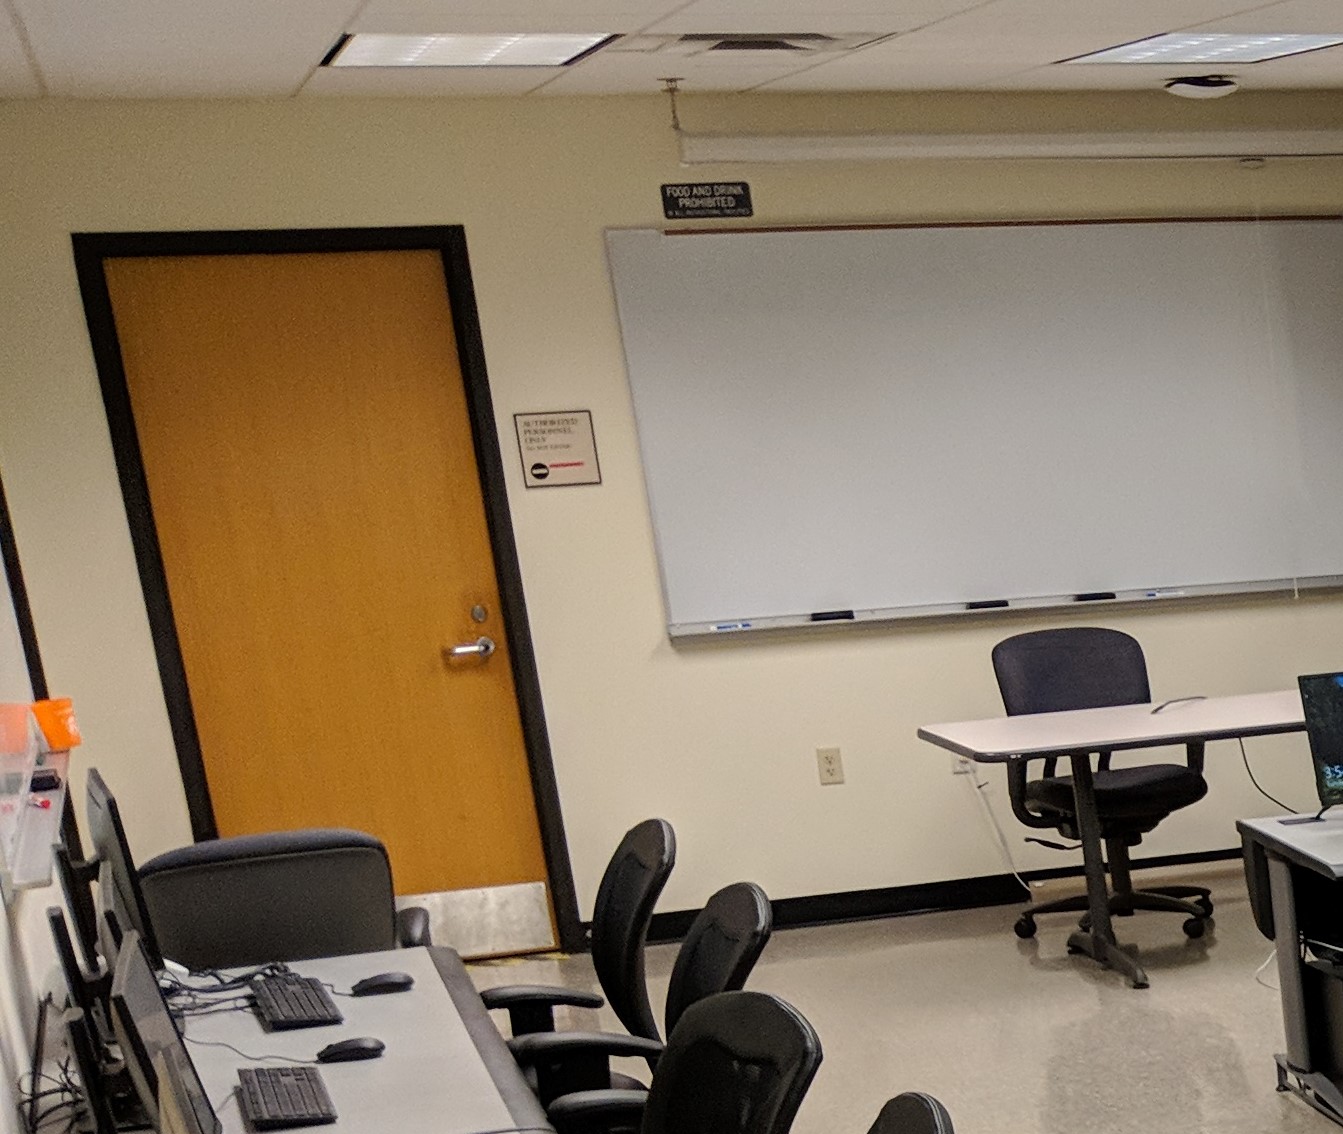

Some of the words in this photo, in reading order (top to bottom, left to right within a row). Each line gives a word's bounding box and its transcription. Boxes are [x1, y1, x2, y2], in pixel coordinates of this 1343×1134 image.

[666, 185, 691, 197] FOOD
[692, 185, 712, 197] AND
[713, 184, 744, 196] DRINK
[678, 196, 736, 208] PROHIBITED
